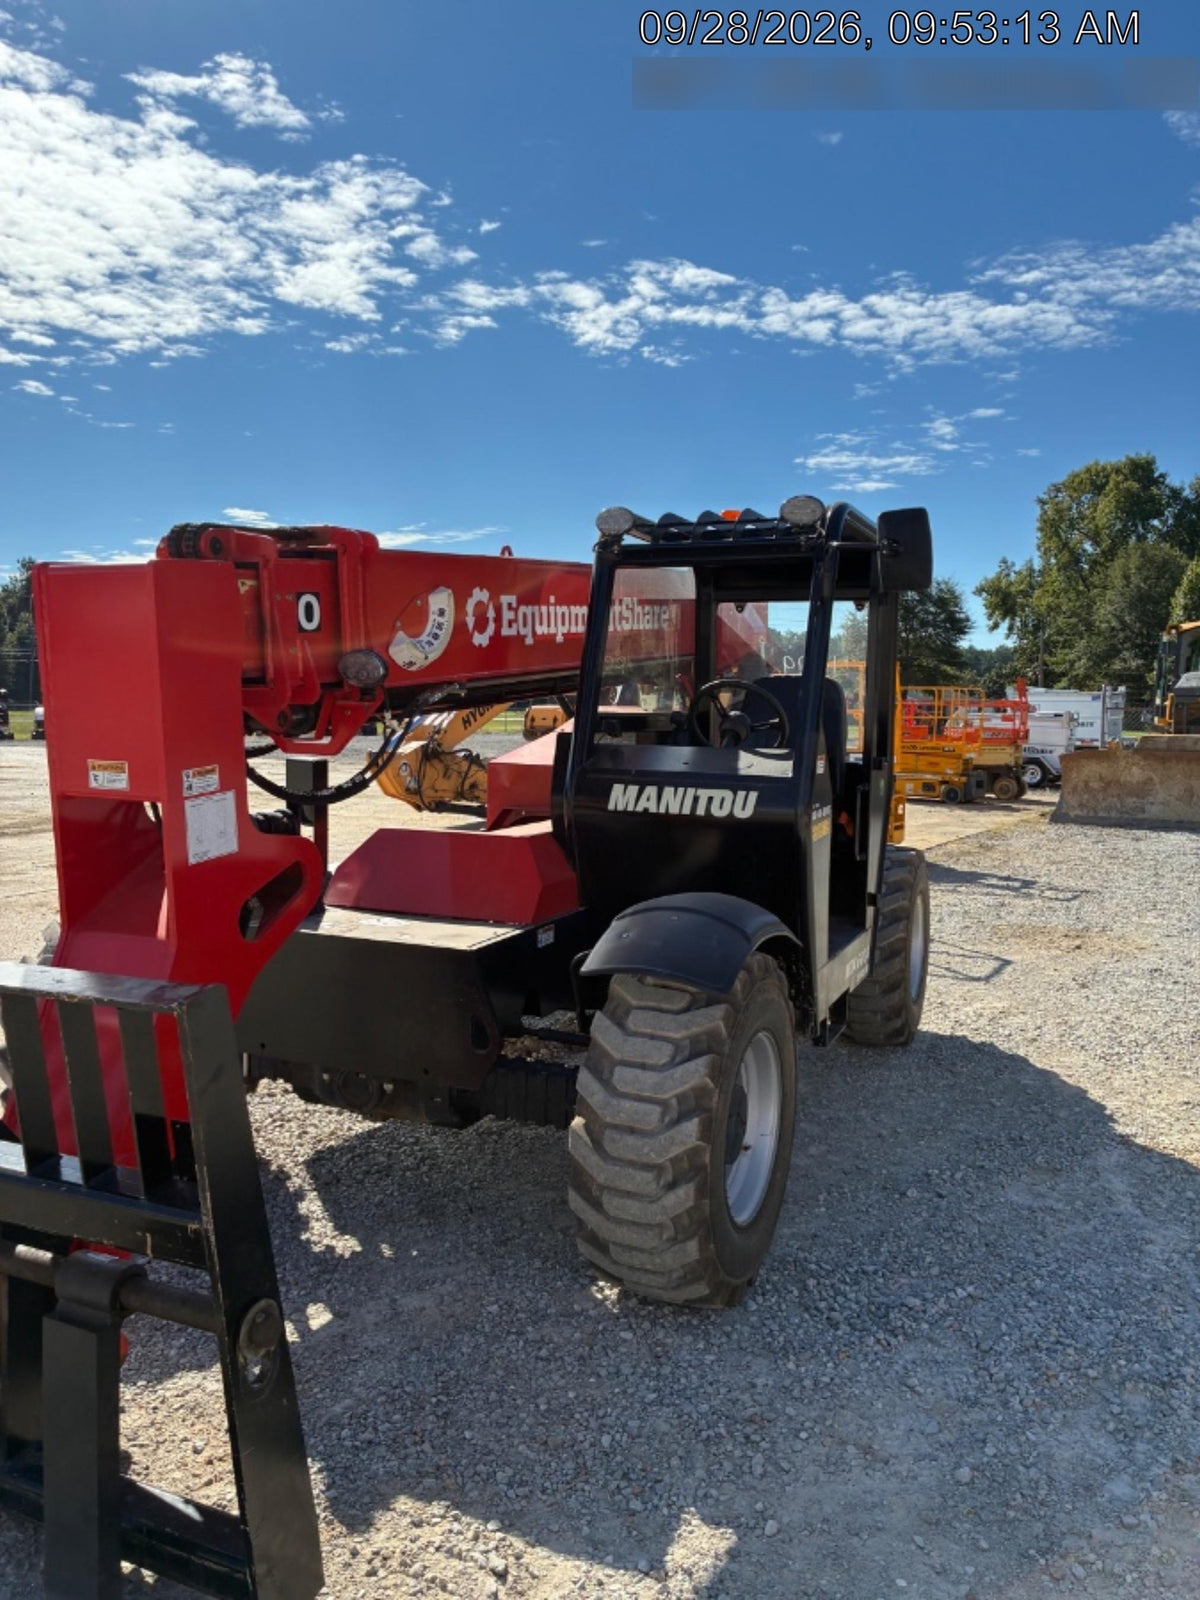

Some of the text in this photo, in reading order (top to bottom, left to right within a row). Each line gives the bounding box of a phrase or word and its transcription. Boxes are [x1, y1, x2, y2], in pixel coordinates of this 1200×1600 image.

[298, 594, 320, 630] 0
[500, 595, 669, 645] EquipmtShare
[607, 783, 759, 819] MANITOU
